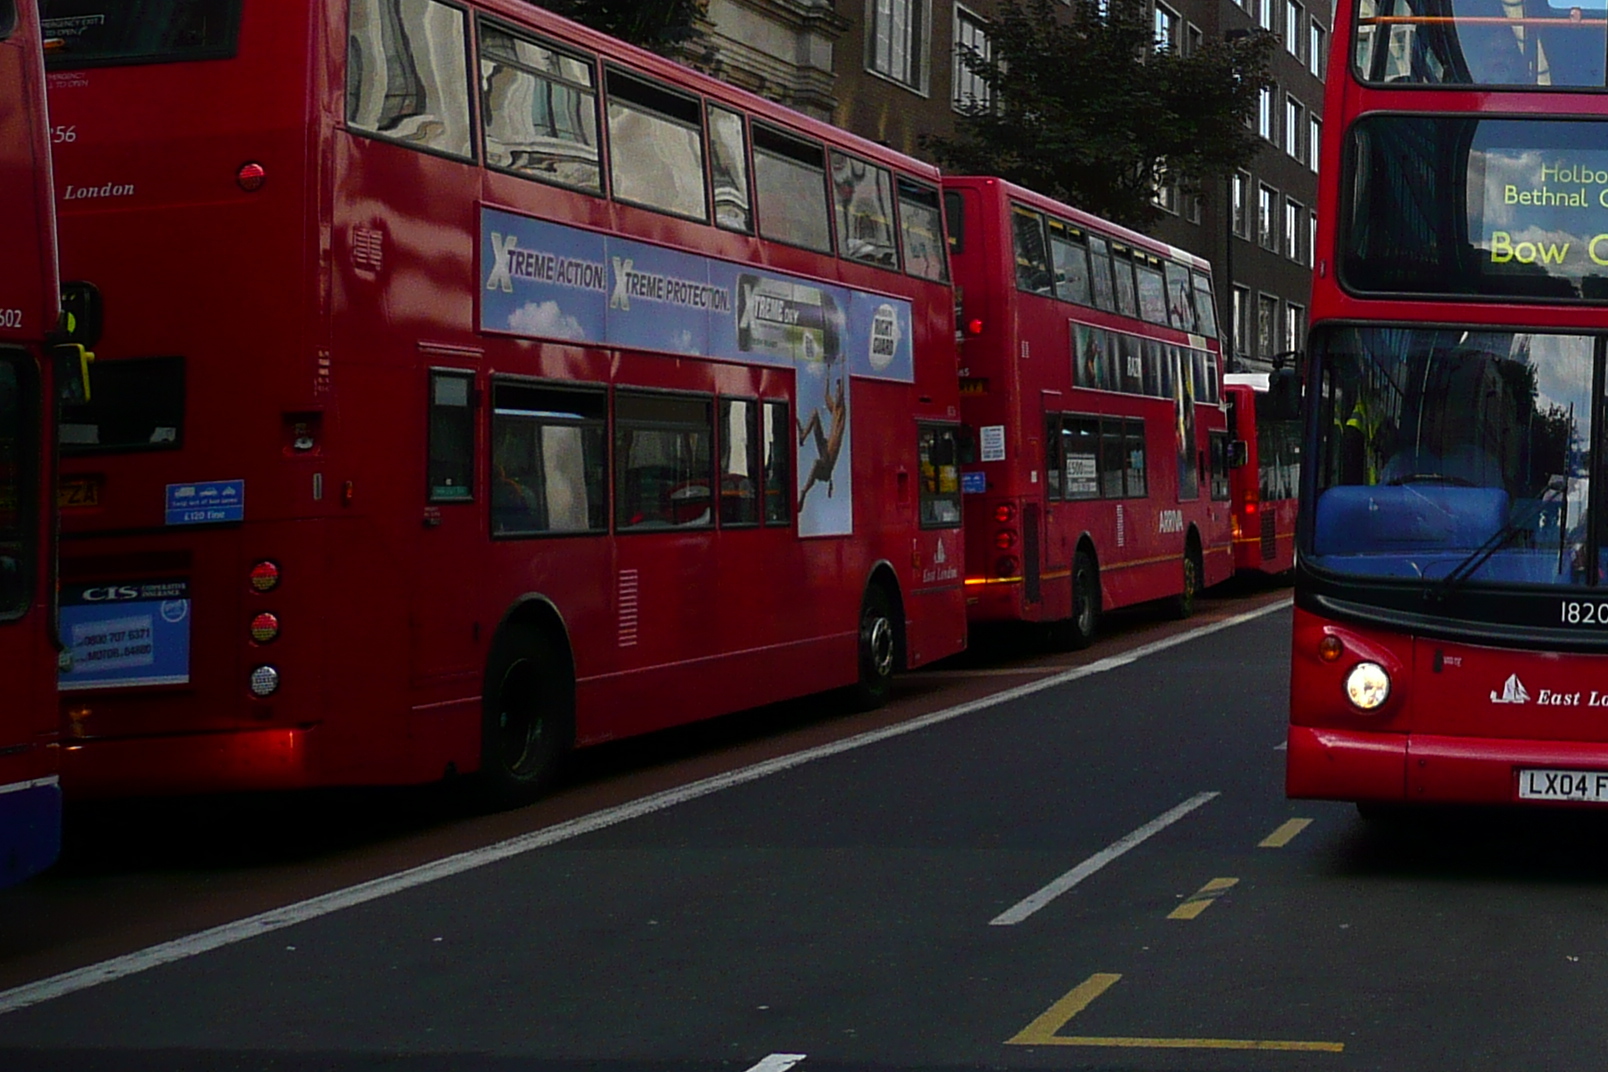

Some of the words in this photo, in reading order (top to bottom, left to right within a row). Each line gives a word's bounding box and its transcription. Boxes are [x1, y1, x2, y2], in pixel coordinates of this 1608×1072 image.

[63, 182, 135, 200] London
[1505, 185, 1588, 208] Bethnal
[1491, 231, 1570, 265] Bow
[1158, 509, 1184, 533] ARRIVA
[82, 585, 138, 601] CIS
[1537, 689, 1581, 707] East
[1530, 773, 1588, 796] LX04
